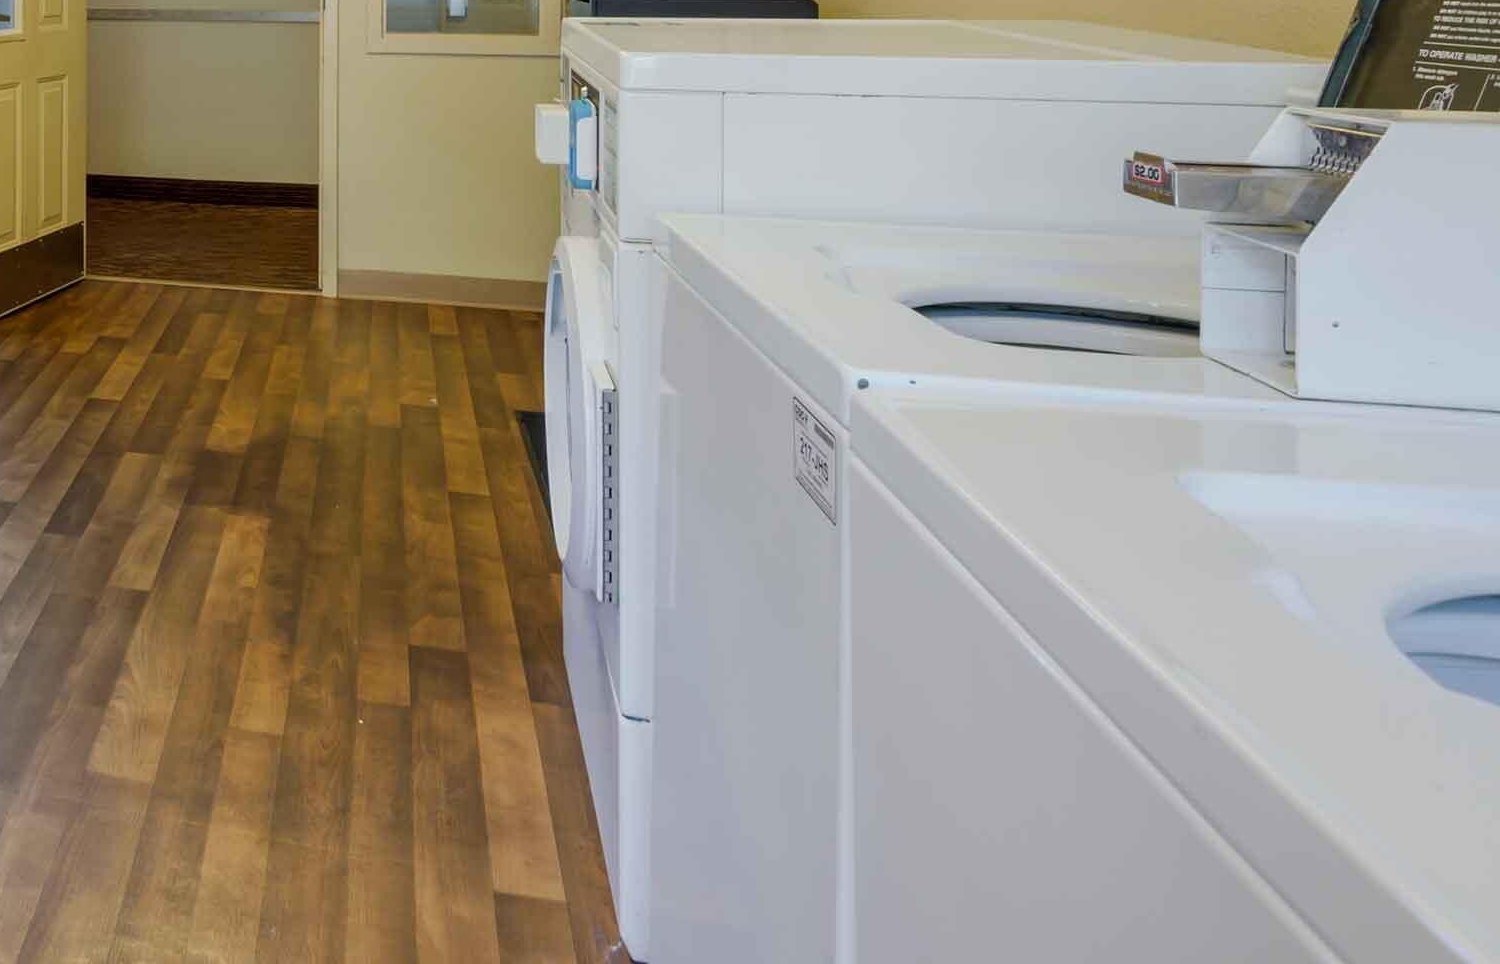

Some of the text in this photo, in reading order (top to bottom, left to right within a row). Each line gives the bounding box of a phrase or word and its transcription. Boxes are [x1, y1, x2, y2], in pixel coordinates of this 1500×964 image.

[1419, 48, 1498, 63] TO OPERATE WASHER
[1134, 164, 1159, 180] $2.00
[800, 436, 829, 482] 217-JHS
